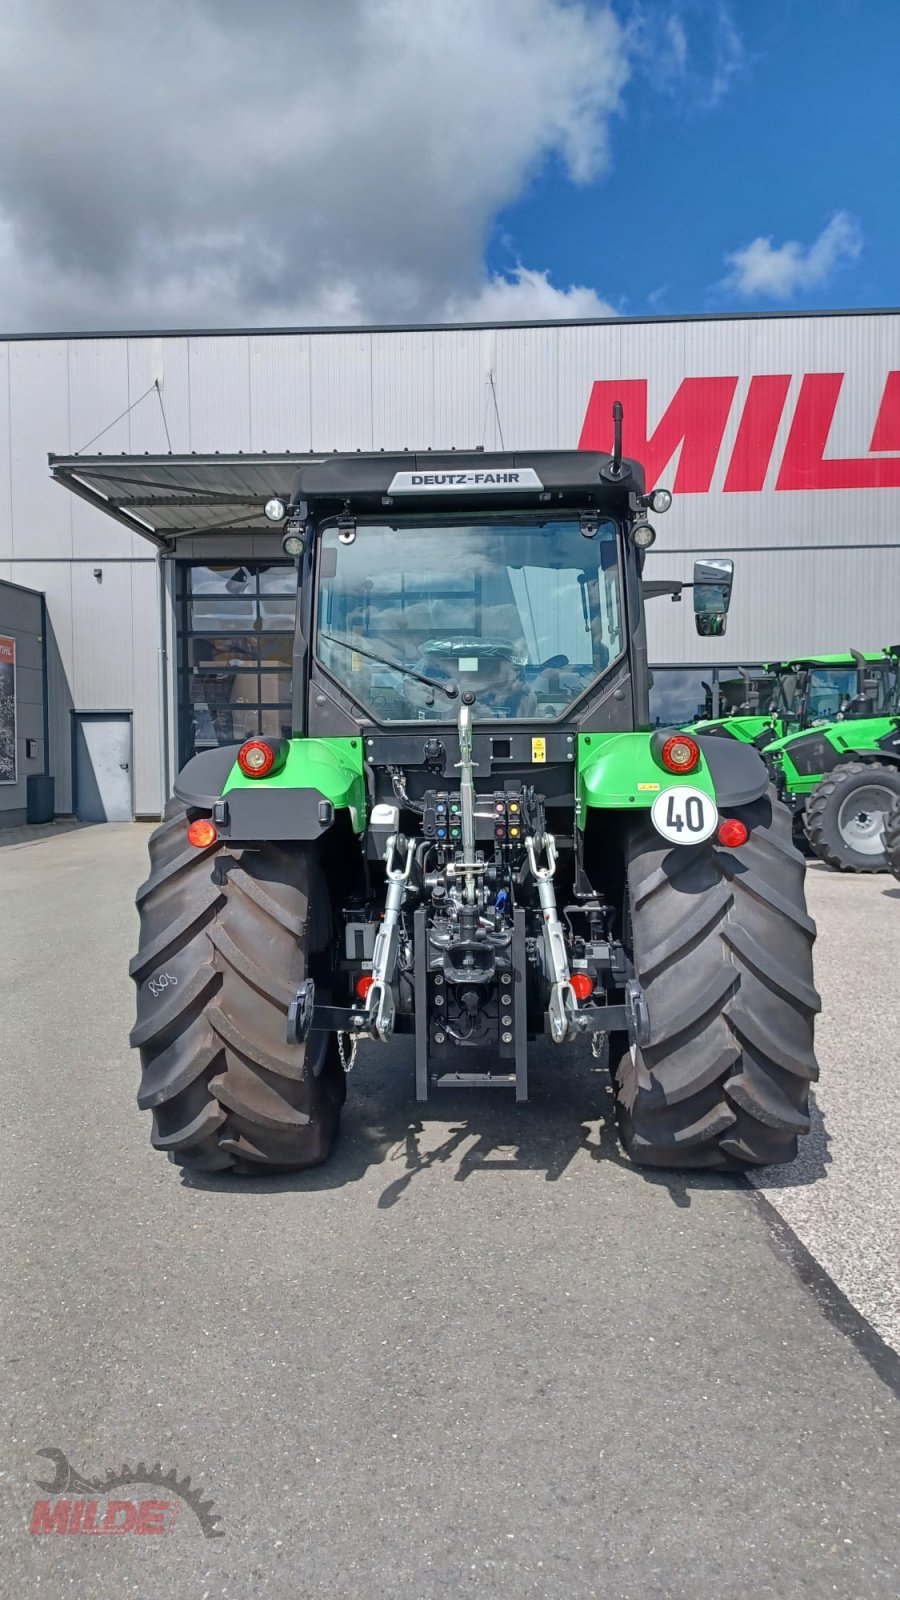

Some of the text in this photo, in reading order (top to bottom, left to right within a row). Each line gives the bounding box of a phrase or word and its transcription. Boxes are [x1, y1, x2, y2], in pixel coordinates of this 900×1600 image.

[577, 371, 900, 494] MIL
[411, 473, 520, 485] DEUTZ-FAHR
[666, 796, 704, 832] 40
